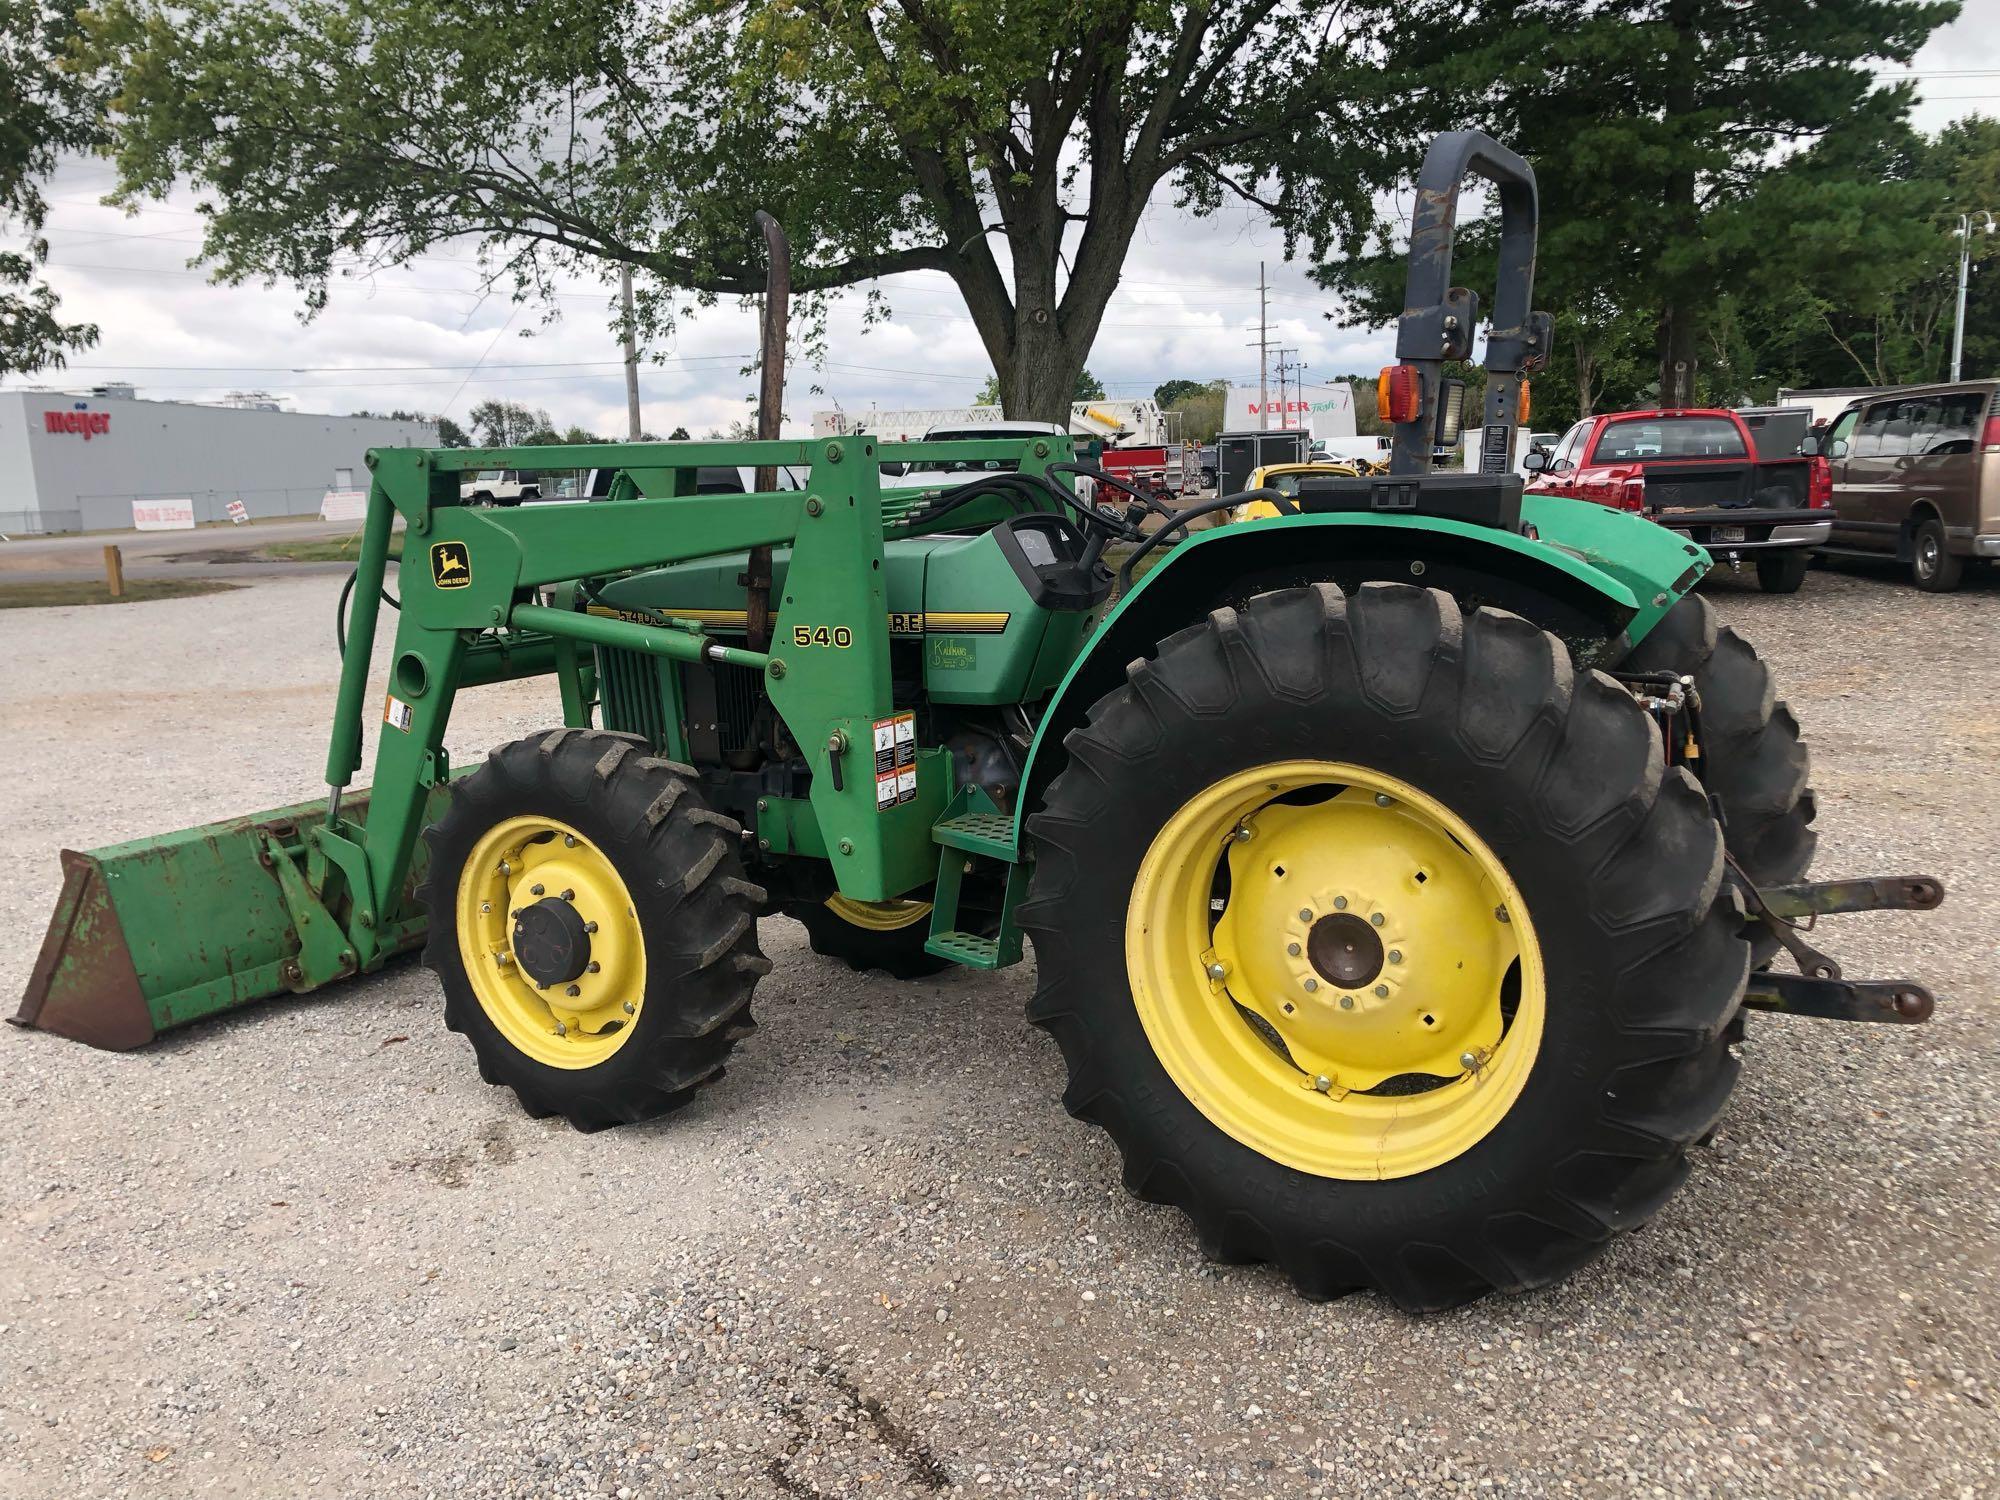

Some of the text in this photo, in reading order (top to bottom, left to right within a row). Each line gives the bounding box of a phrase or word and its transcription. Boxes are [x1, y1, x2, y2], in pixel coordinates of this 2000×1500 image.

[1248, 401, 1310, 414] MEIER
[44, 403, 111, 441] meijer
[793, 625, 853, 649] 540
